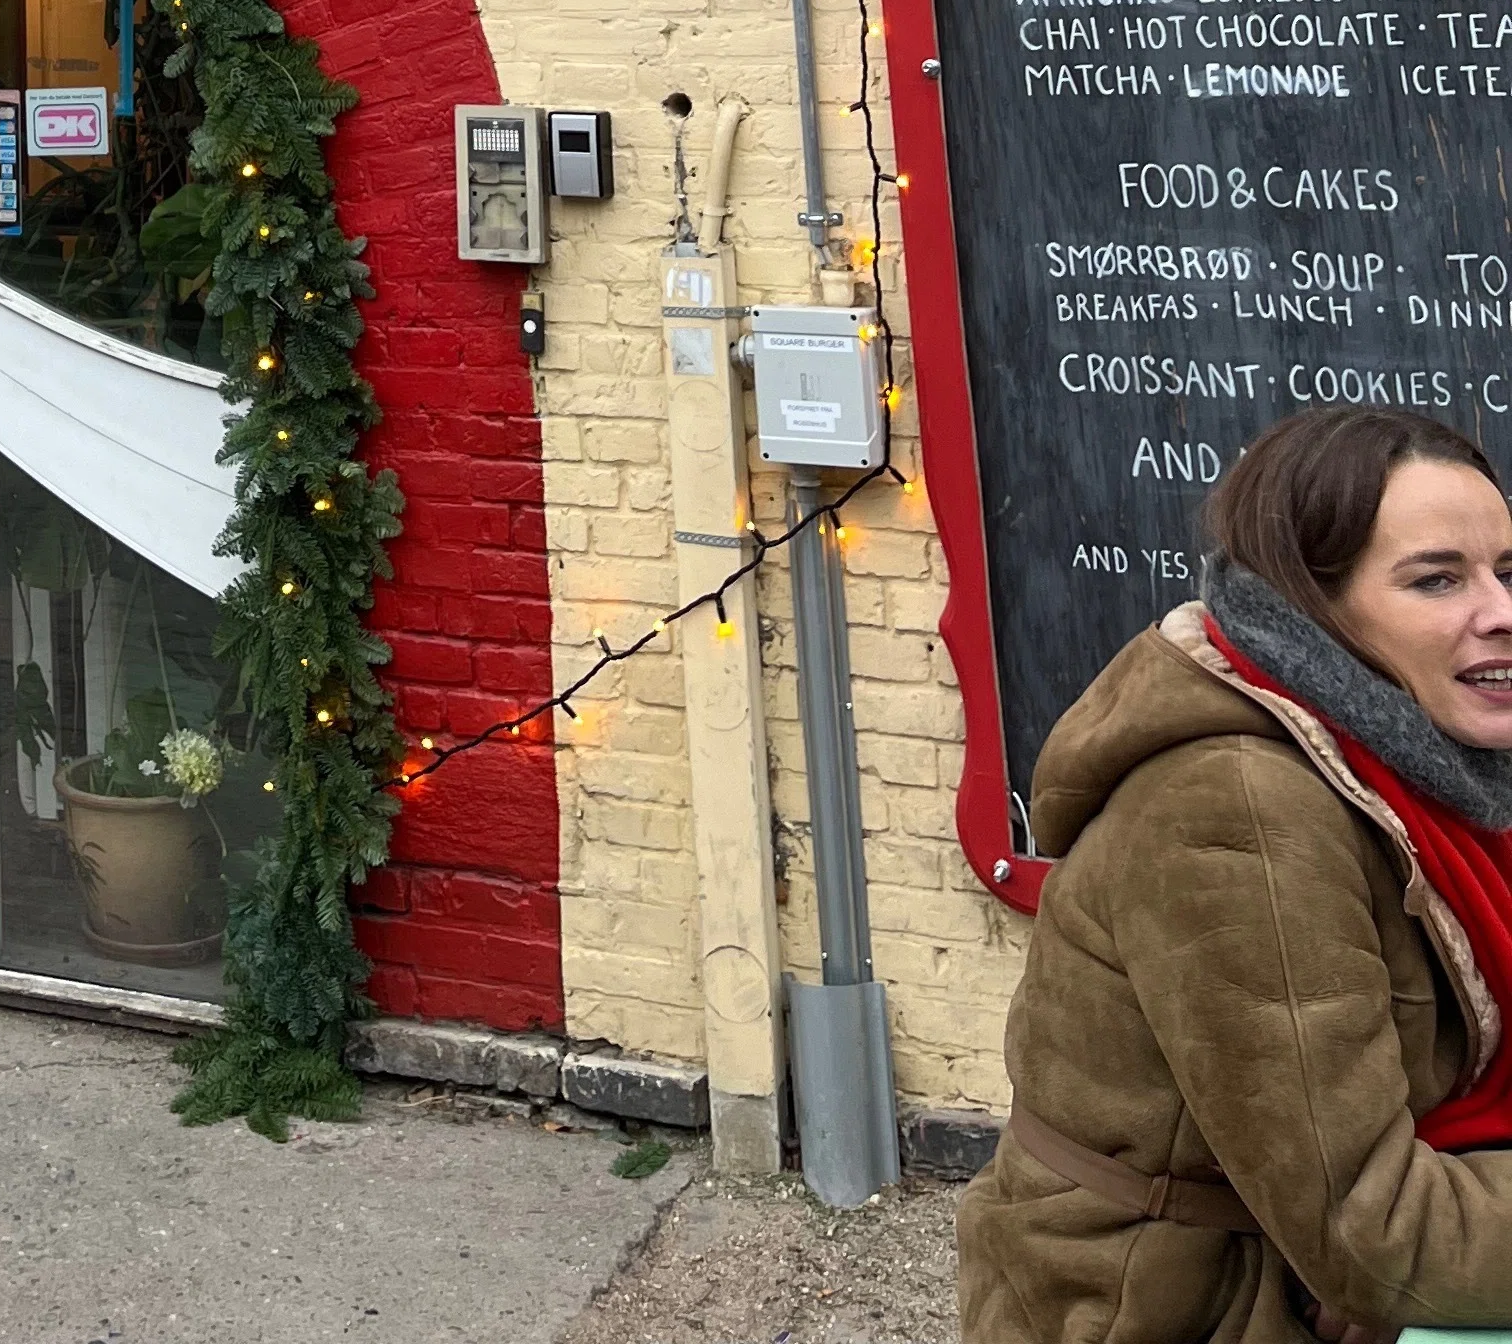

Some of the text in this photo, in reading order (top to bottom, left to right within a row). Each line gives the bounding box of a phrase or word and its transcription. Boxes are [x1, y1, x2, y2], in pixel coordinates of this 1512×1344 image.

[1020, 17, 1100, 50] CHAI
[1124, 16, 1185, 49] HOT
[1195, 14, 1404, 48] CHOCOLATE
[1025, 64, 1160, 96] MATCHA
[1185, 62, 1350, 98] LEMONADE
[1118, 162, 1398, 211] FOOD & CAKES
[1291, 250, 1384, 292] SOUP
[1056, 294, 1512, 329] BREAKFAS LUNCH DINN
[1059, 353, 1261, 399] CROISSANT
[1289, 364, 1451, 407] COOKIES
[1131, 437, 1220, 483] AND
[1072, 544, 1129, 574] AND
